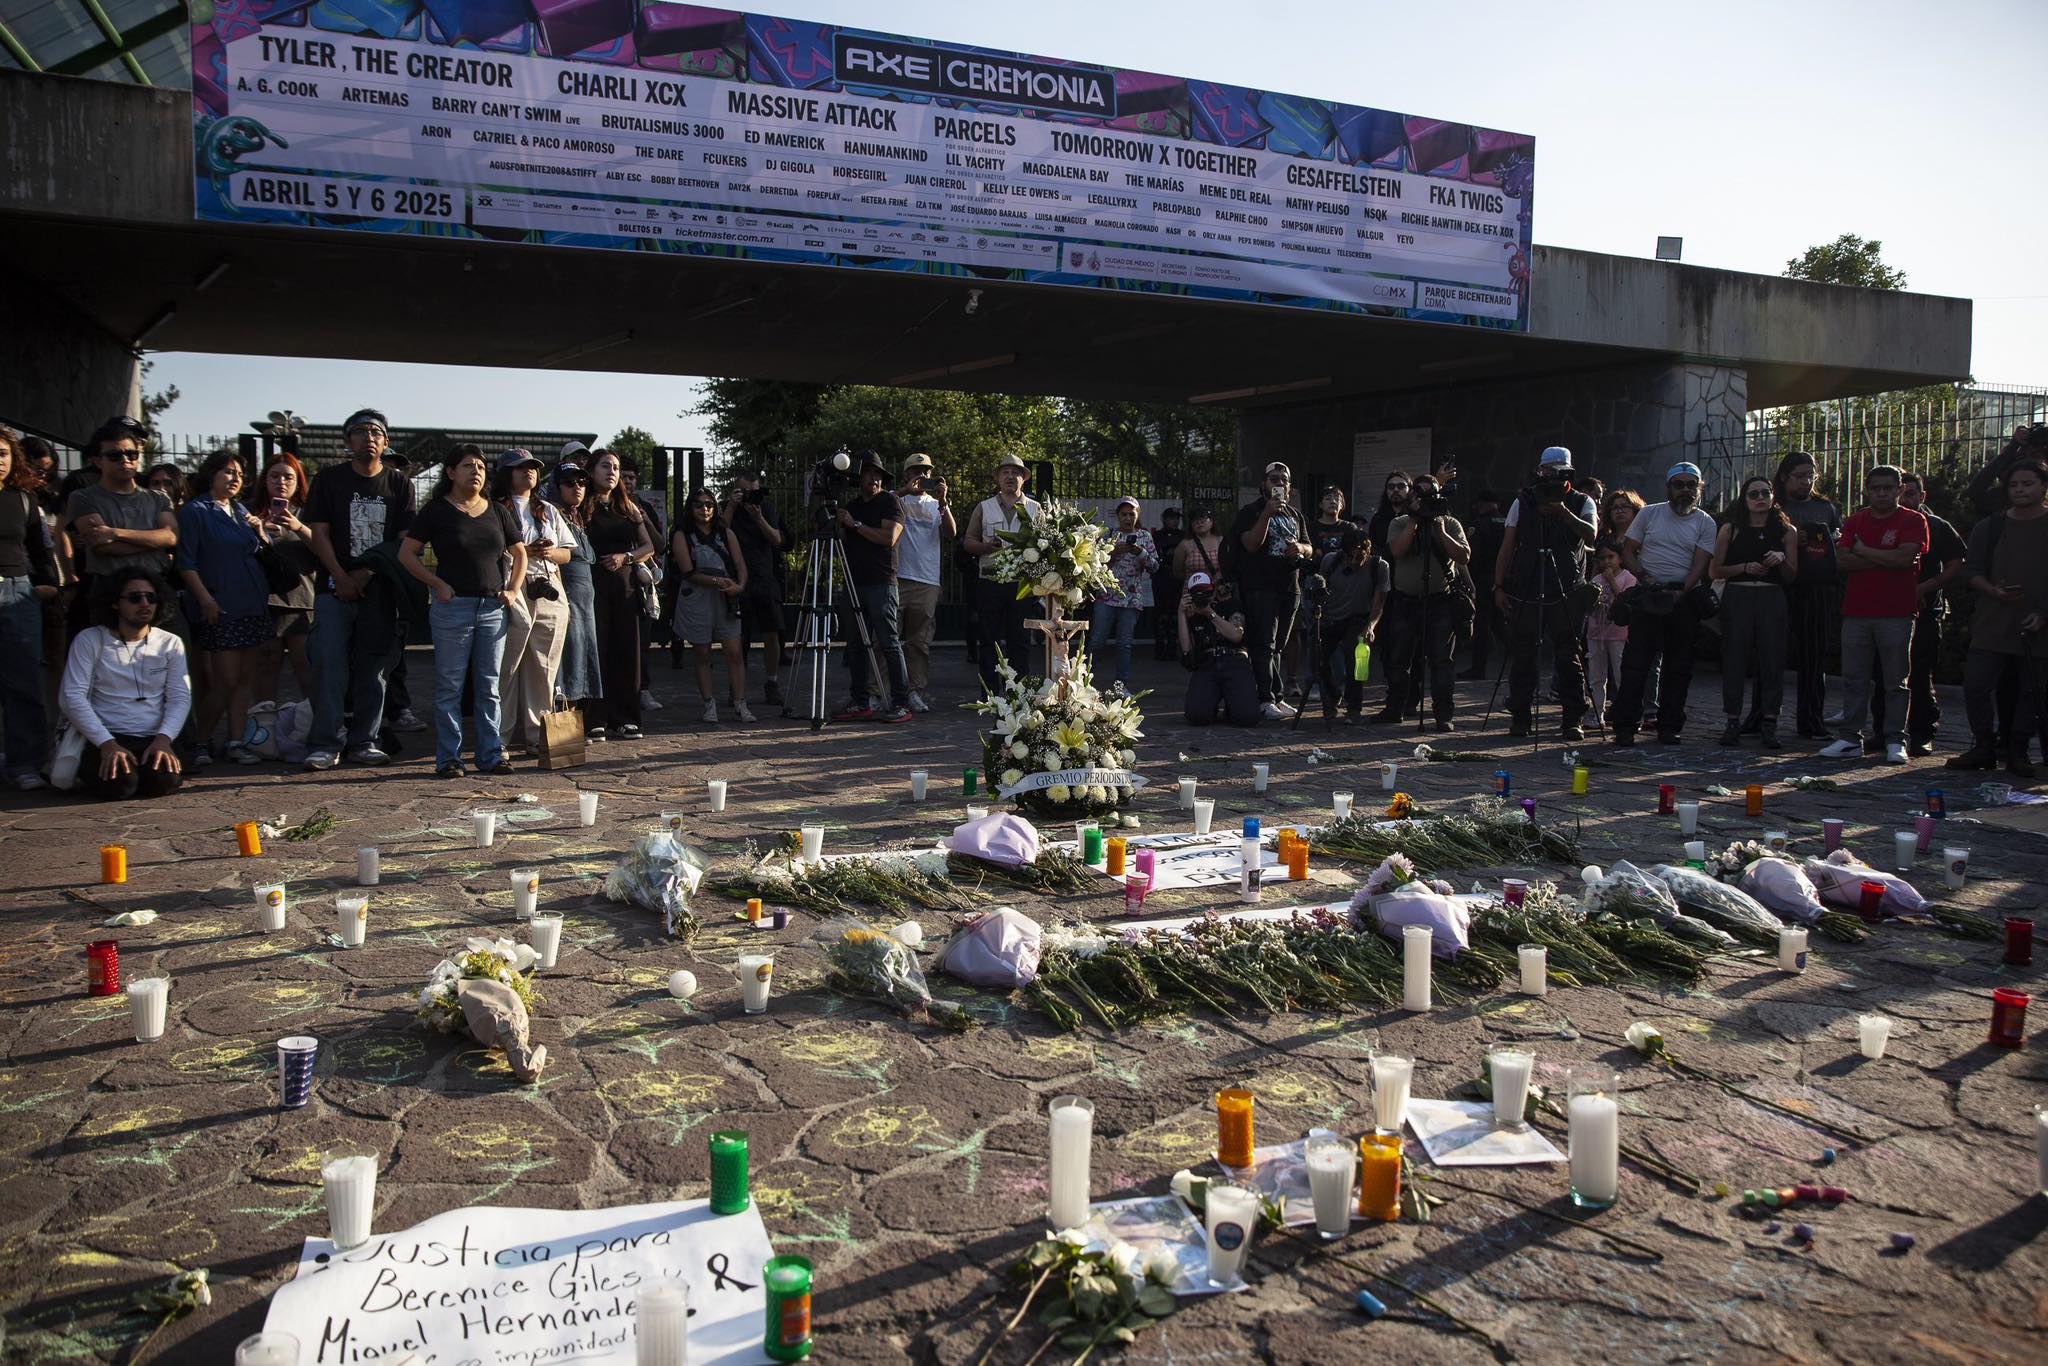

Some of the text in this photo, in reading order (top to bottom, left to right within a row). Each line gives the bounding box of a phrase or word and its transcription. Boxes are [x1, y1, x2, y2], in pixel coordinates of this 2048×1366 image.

[846, 48, 1106, 109] AXE CEREMONIA
[352, 46, 398, 75] THE
[407, 53, 512, 88] CREATOR
[558, 71, 636, 101] CHARLI
[645, 80, 687, 107] XCX
[728, 90, 819, 122] MASSIVE
[825, 103, 897, 132] ATTACK
[935, 116, 1016, 148] PARCELS
[1051, 131, 1154, 163] TOMORROW
[1159, 145, 1170, 165] X
[1175, 147, 1256, 178] TOGETHER
[1287, 164, 1401, 199] GESAFFELSTEIN
[1430, 185, 1456, 207] FKA
[1460, 190, 1503, 214] TWIGS
[237, 77, 1513, 239] A. G. COOK ARTEMAS BARRY CAN'T SWIM LIVE BRUTALISMUS 3000 ED MAVERICK HANUMANKIND LIL YACHTY MAGDALENA BAY THE MARÍAS MEME DEL REAL NATHY PELUSO NSQK RICHIE HAWTIN DEX EFX XOX
[243, 178, 452, 216] ABRIL 5 Y 6 2025
[421, 125, 451, 138] ARON
[473, 130, 517, 145] CA7RIEL
[521, 135, 529, 146] &
[533, 136, 560, 149] PACO
[564, 139, 614, 154] AMOROSO
[635, 146, 654, 158] THE
[658, 148, 684, 161] DARE
[703, 153, 747, 167] FCUKERS
[766, 159, 776, 170] DJ
[780, 161, 815, 174] GIGOLA
[833, 166, 887, 181] HORSEGIIRL
[905, 174, 926, 186] JUAN
[930, 177, 966, 190] CIREROL
[984, 183, 1008, 194] KELLY
[1012, 186, 1027, 196] LEE
[1029, 187, 1059, 199] OWENS
[1088, 194, 1137, 208] LEGALLYRXX
[1153, 202, 1201, 216] PABLOPABLO
[1216, 210, 1246, 223] RALPHIE
[1248, 215, 1268, 226] CHOO
[1281, 220, 1313, 232] SIMPSON
[1315, 224, 1343, 236] AHUEVO
[1357, 229, 1383, 240] VALGUR
[1397, 234, 1414, 245] YEYO
[606, 172, 624, 180] ALBY
[627, 173, 641, 182] ESC
[651, 175, 675, 185] BOBBY
[678, 178, 719, 189] BEETHOVEN
[728, 183, 751, 192] DAY2K
[760, 186, 798, 197] DERRETIDA
[807, 190, 840, 200] FOREPLAY
[861, 196, 887, 205] HETERA
[889, 196, 908, 207] FRINÉ
[916, 201, 927, 209] IZA
[929, 202, 942, 210] TKM
[950, 205, 965, 213] JOSÉ
[967, 206, 997, 216] EDUARDO
[999, 209, 1027, 219] BARAJAS
[1035, 213, 1053, 222] LUISA
[1054, 215, 1087, 224] ALMAGUER
[1095, 219, 1125, 229] MAGNOLIA
[1127, 223, 1158, 232] CORONADO
[1166, 227, 1181, 235] NASH
[1253, 239, 1275, 248] ROMERO
[1307, 246, 1331, 255] MARCELA
[1337, 250, 1372, 259] TELESCREENS
[619, 224, 650, 233] BOLETOS
[676, 228, 774, 243] ticketmaster.com.mx
[1373, 285, 1406, 298] CDMX
[1425, 287, 1511, 305] PARQUE BICENTENARIO
[1425, 297, 1446, 309] CDMX
[1194, 487, 1232, 501] ENTRADA
[1036, 772, 1082, 787] GREMIO
[572, 1230, 671, 1277] para
[360, 1268, 529, 1313] Berenice
[548, 1261, 642, 1302] Giles
